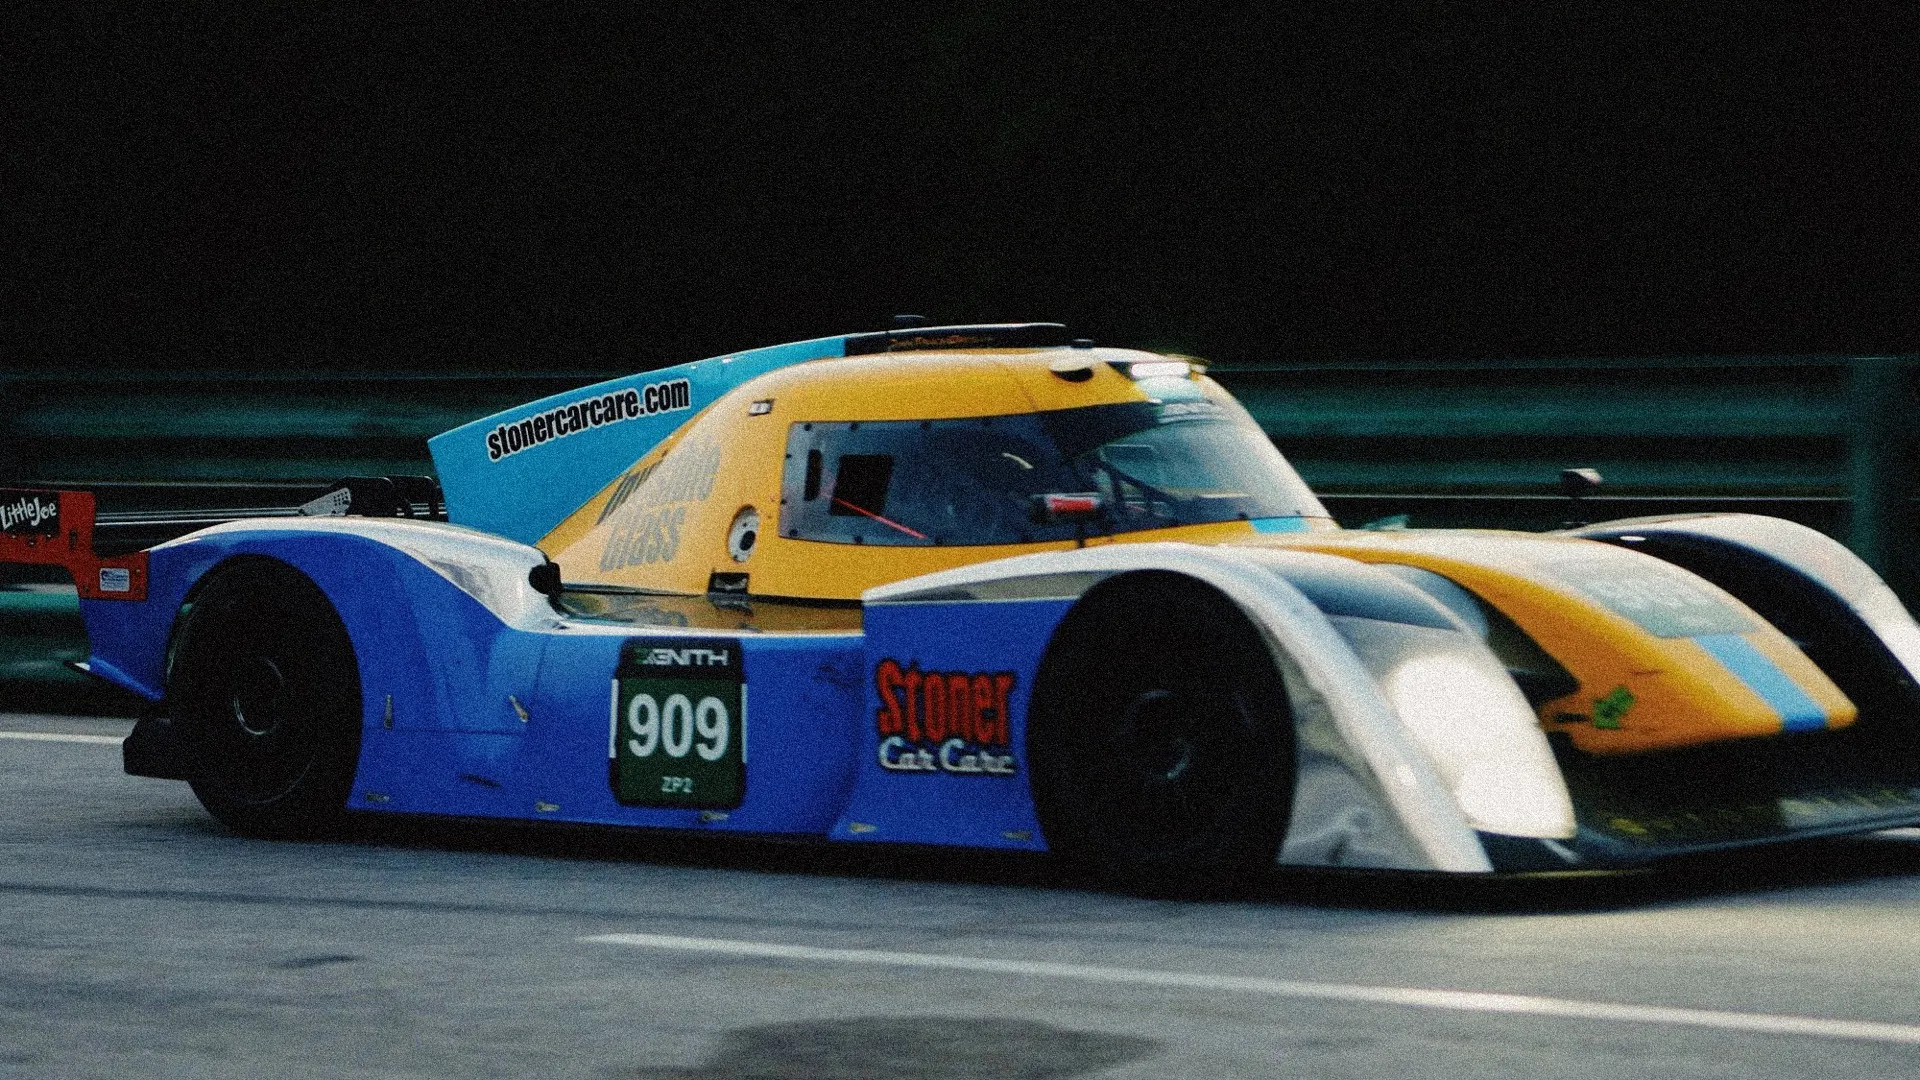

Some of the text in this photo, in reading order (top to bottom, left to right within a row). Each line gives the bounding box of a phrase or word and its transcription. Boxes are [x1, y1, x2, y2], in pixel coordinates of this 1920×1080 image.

[487, 379, 690, 461] stonercarcare.com
[628, 693, 729, 761] 909
[878, 660, 1014, 744] Stoner
[878, 736, 937, 771] Car
